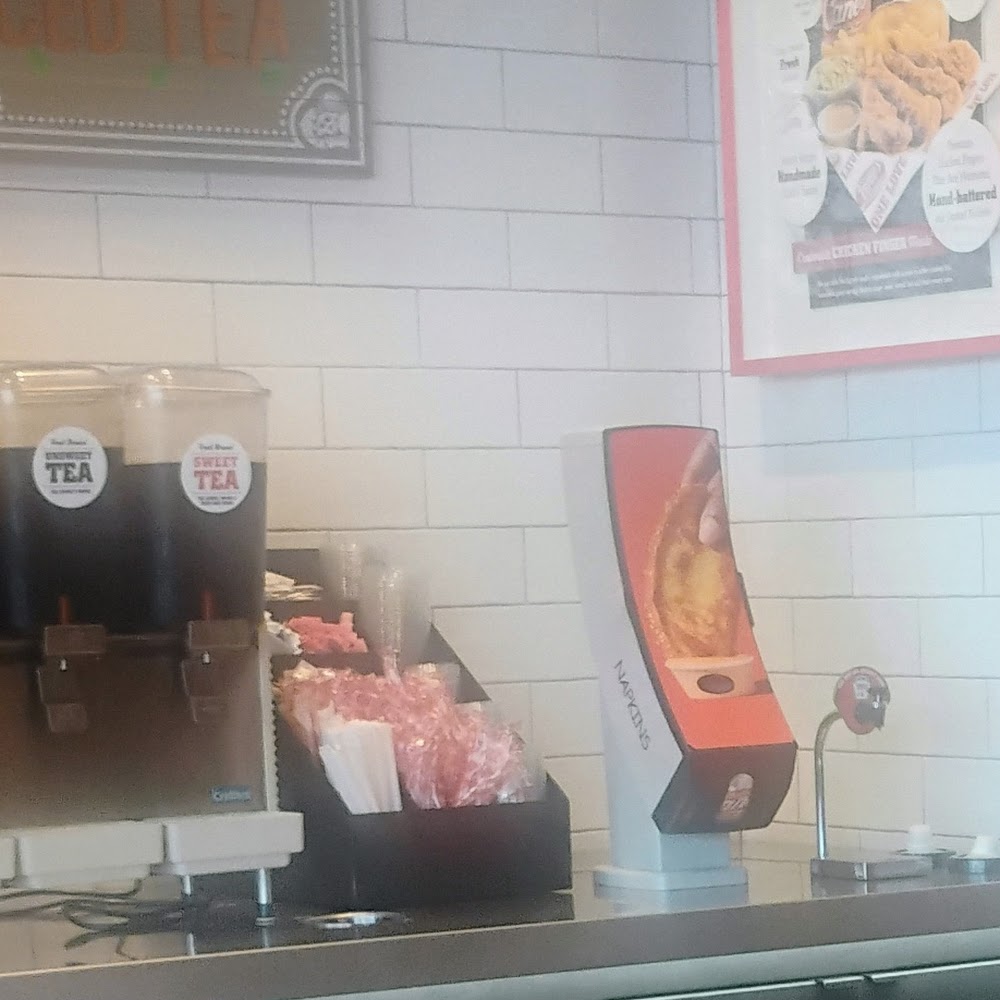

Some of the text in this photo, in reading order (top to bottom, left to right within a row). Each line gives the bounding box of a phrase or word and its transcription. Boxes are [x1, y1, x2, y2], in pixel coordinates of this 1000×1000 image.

[928, 184, 998, 207] Hand-battered
[45, 461, 94, 484] TEA
[194, 456, 238, 468] SWEET
[193, 470, 239, 490] TEA
[613, 659, 652, 751] NAPKINS
